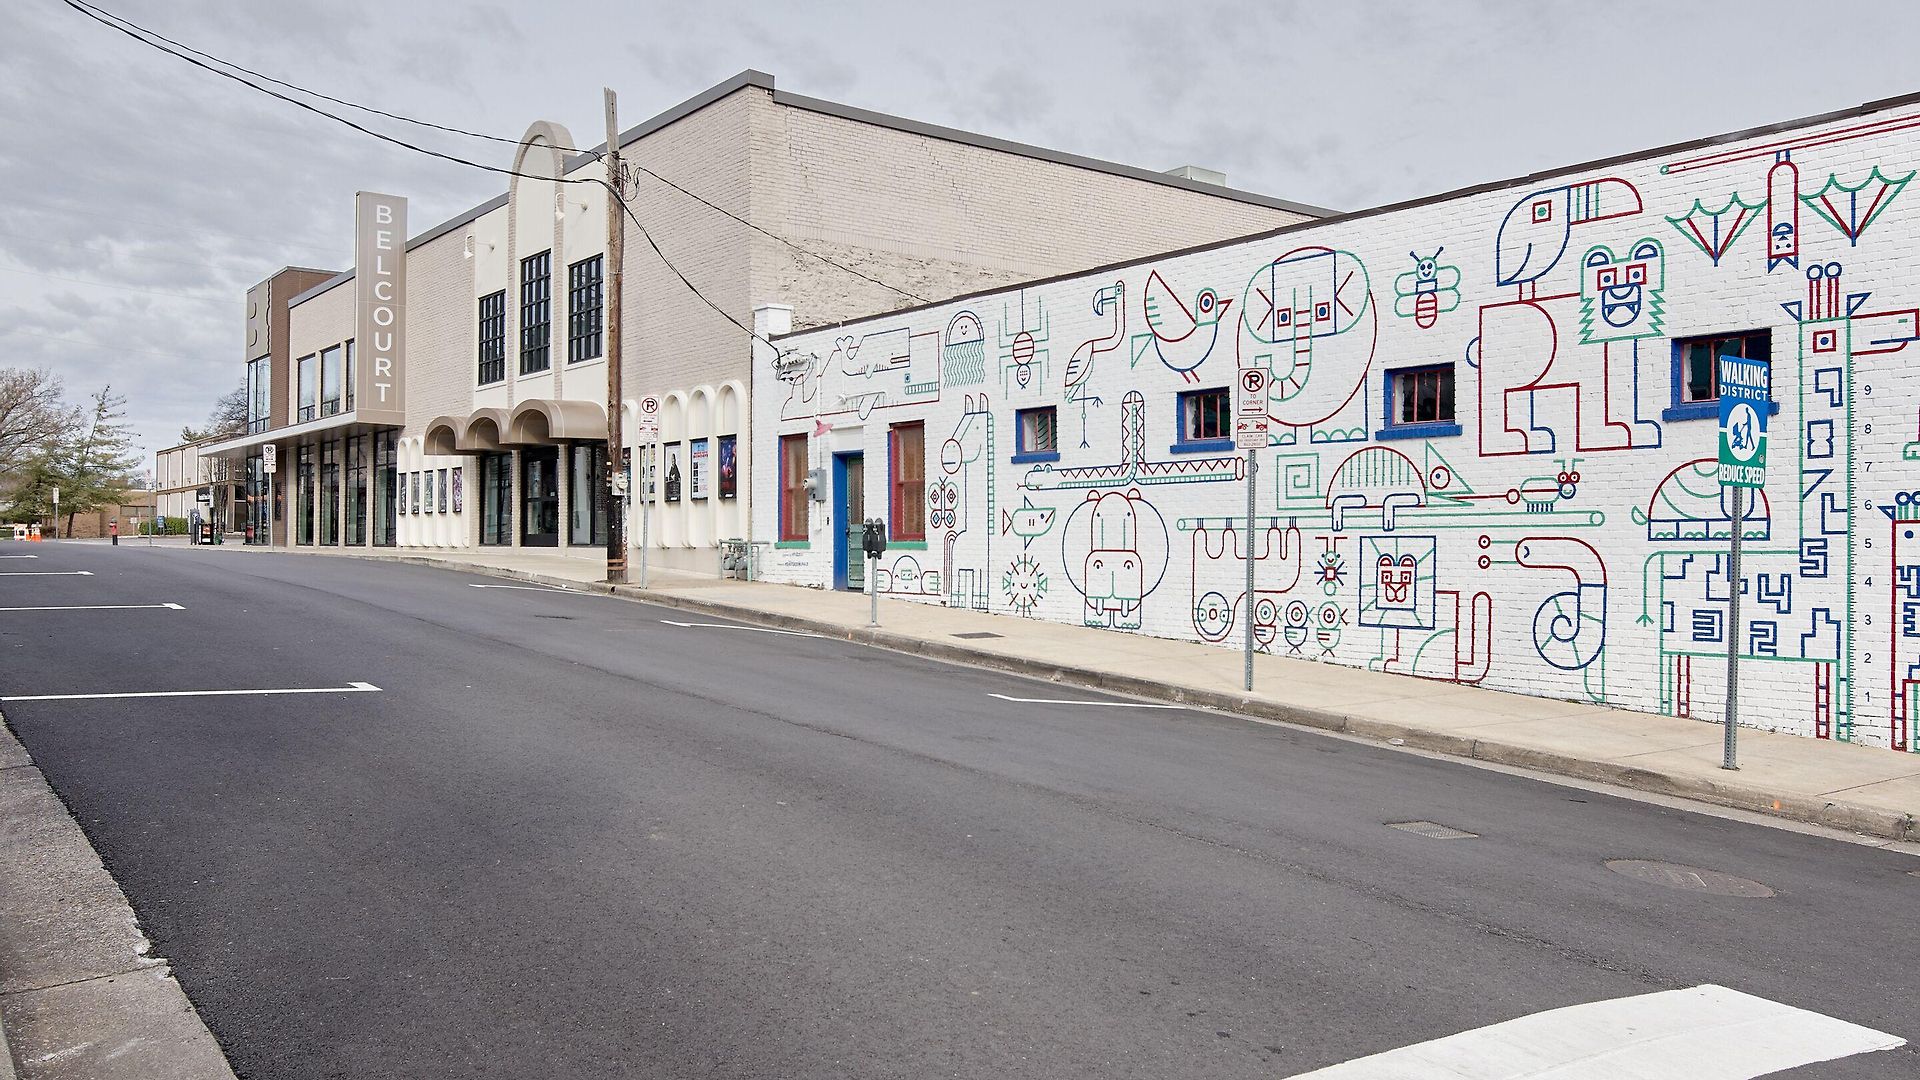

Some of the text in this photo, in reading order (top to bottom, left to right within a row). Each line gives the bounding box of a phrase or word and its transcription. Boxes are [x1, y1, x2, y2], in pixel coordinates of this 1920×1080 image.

[373, 203, 394, 403] BELCOURT
[1720, 360, 1768, 389] WALKING
[1720, 384, 1768, 401] DISTRICT
[1864, 384, 1872, 396] 9
[1864, 423, 1872, 435] 8
[1864, 461, 1873, 472] 7
[1718, 463, 1765, 485] REDUCE SPEED
[1864, 499, 1873, 511] 6
[1864, 537, 1872, 549] 5
[1864, 576, 1873, 588] 4
[1864, 614, 1872, 626] 3
[1863, 652, 1872, 664] 2
[1865, 691, 1871, 702] 1
